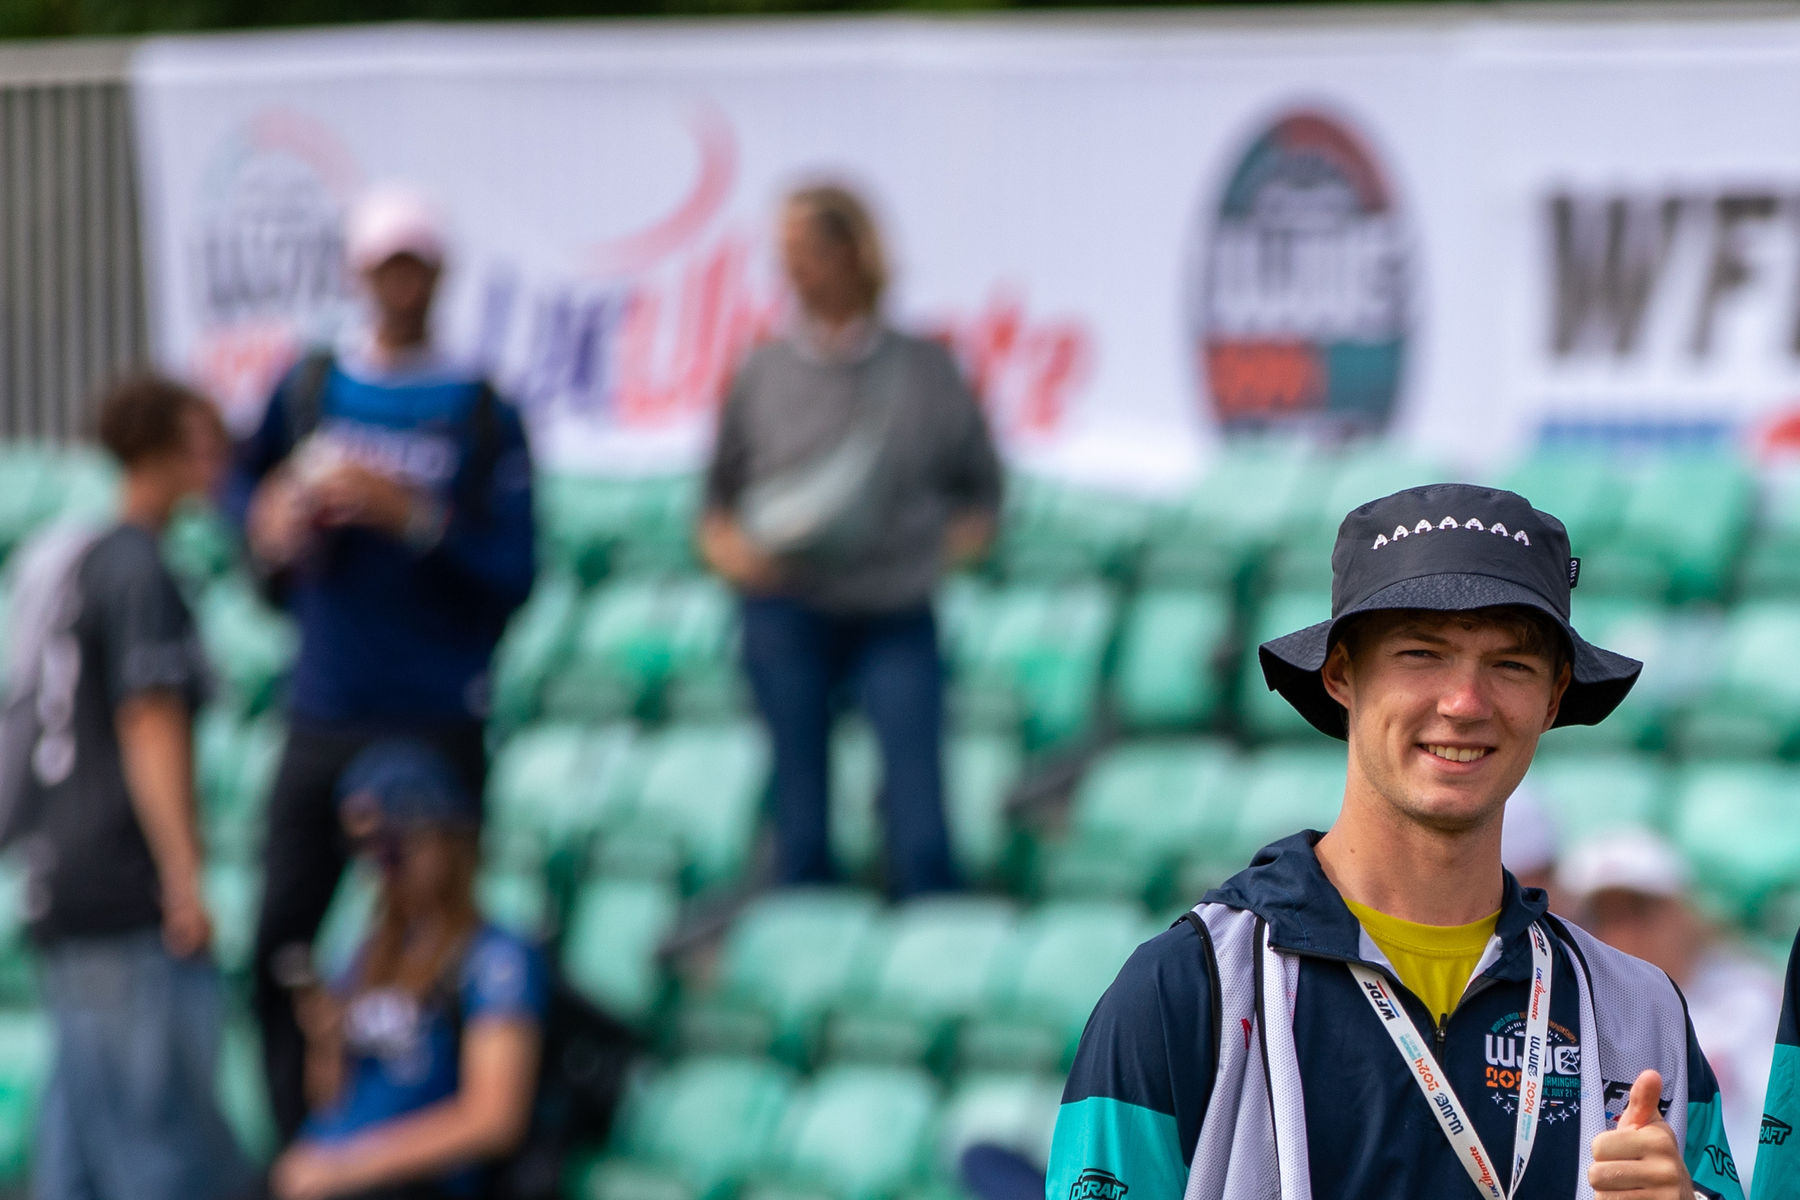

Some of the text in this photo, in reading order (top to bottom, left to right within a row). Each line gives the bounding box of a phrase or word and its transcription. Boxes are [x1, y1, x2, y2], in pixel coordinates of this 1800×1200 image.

[1364, 980, 1396, 1021] WFDF
[1414, 1057, 1440, 1093] 2024
[1527, 1035, 1541, 1077] WJUE
[1523, 1080, 1537, 1114] 2024
[1544, 1075, 1581, 1089] IRMINGHA
[1433, 1092, 1465, 1136] WJUE
